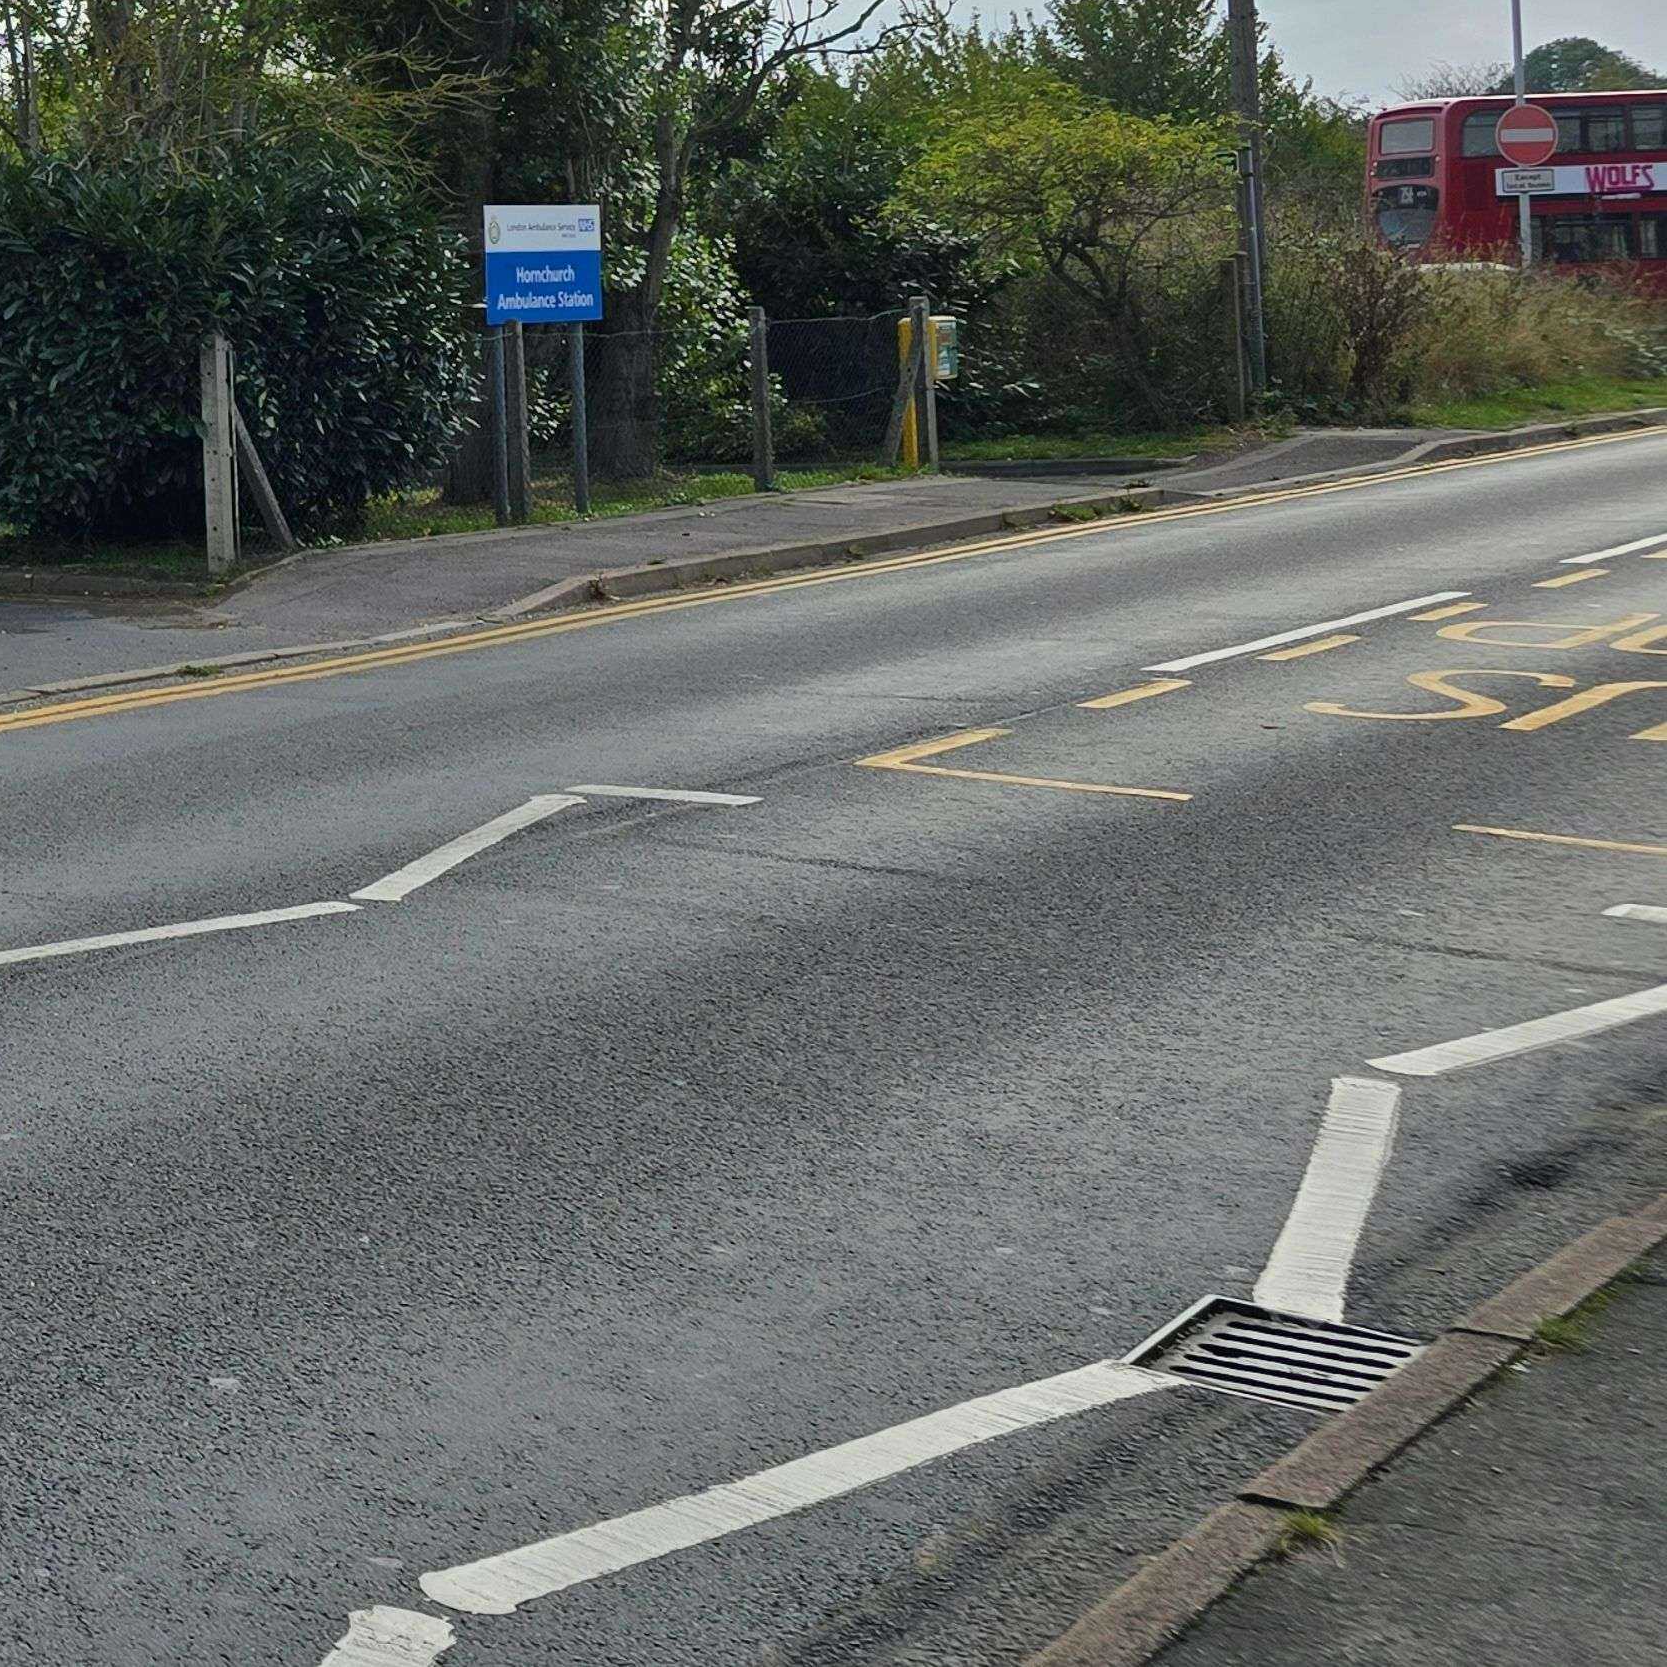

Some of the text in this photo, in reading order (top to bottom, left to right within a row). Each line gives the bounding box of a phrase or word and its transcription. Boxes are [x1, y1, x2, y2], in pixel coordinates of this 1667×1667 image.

[1585, 165, 1655, 194] WOLFS
[516, 265, 576, 283] Hornchurch
[497, 290, 594, 310] Ambulance Station
